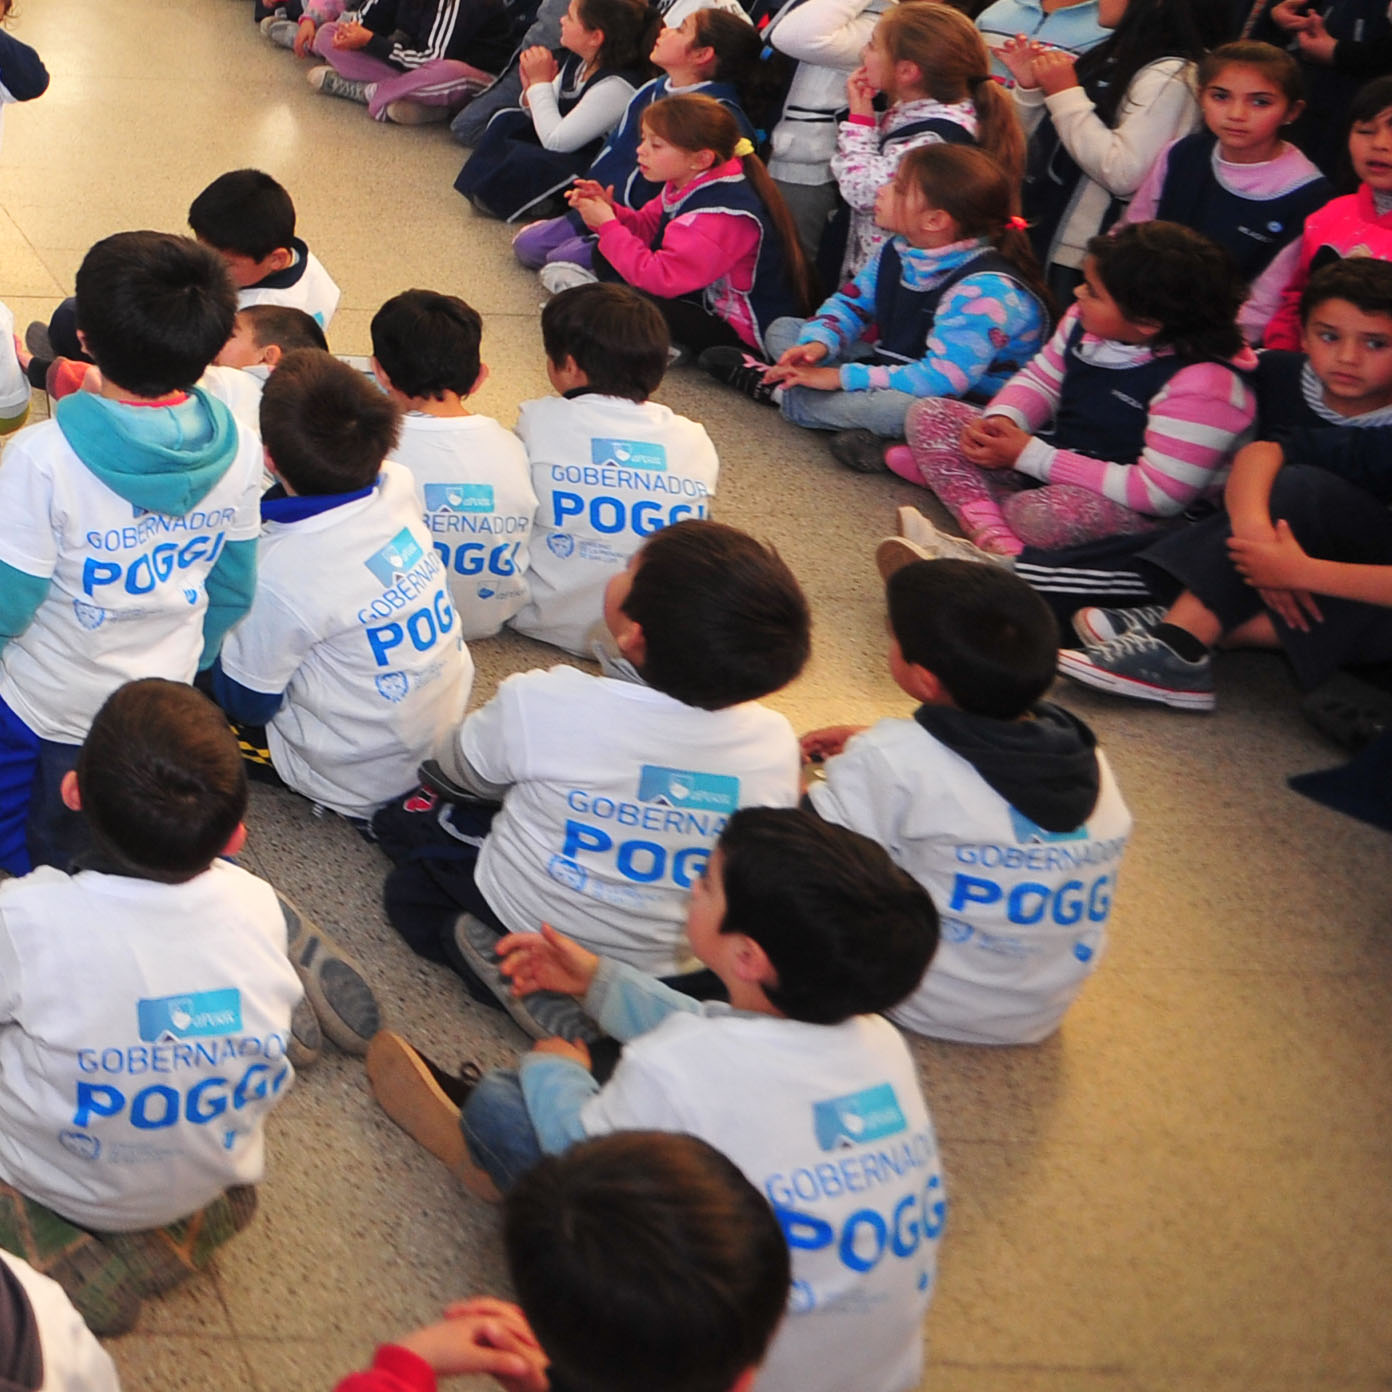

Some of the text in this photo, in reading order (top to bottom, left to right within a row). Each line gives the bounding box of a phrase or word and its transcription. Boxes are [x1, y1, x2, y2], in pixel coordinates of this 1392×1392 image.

[552, 464, 708, 498] GOBERNADOR
[86, 507, 236, 552] GOBERNADOR
[82, 531, 225, 598] POGGI
[366, 589, 454, 667] POG
[562, 818, 711, 891] POG
[76, 1033, 286, 1076] GOBERNADO
